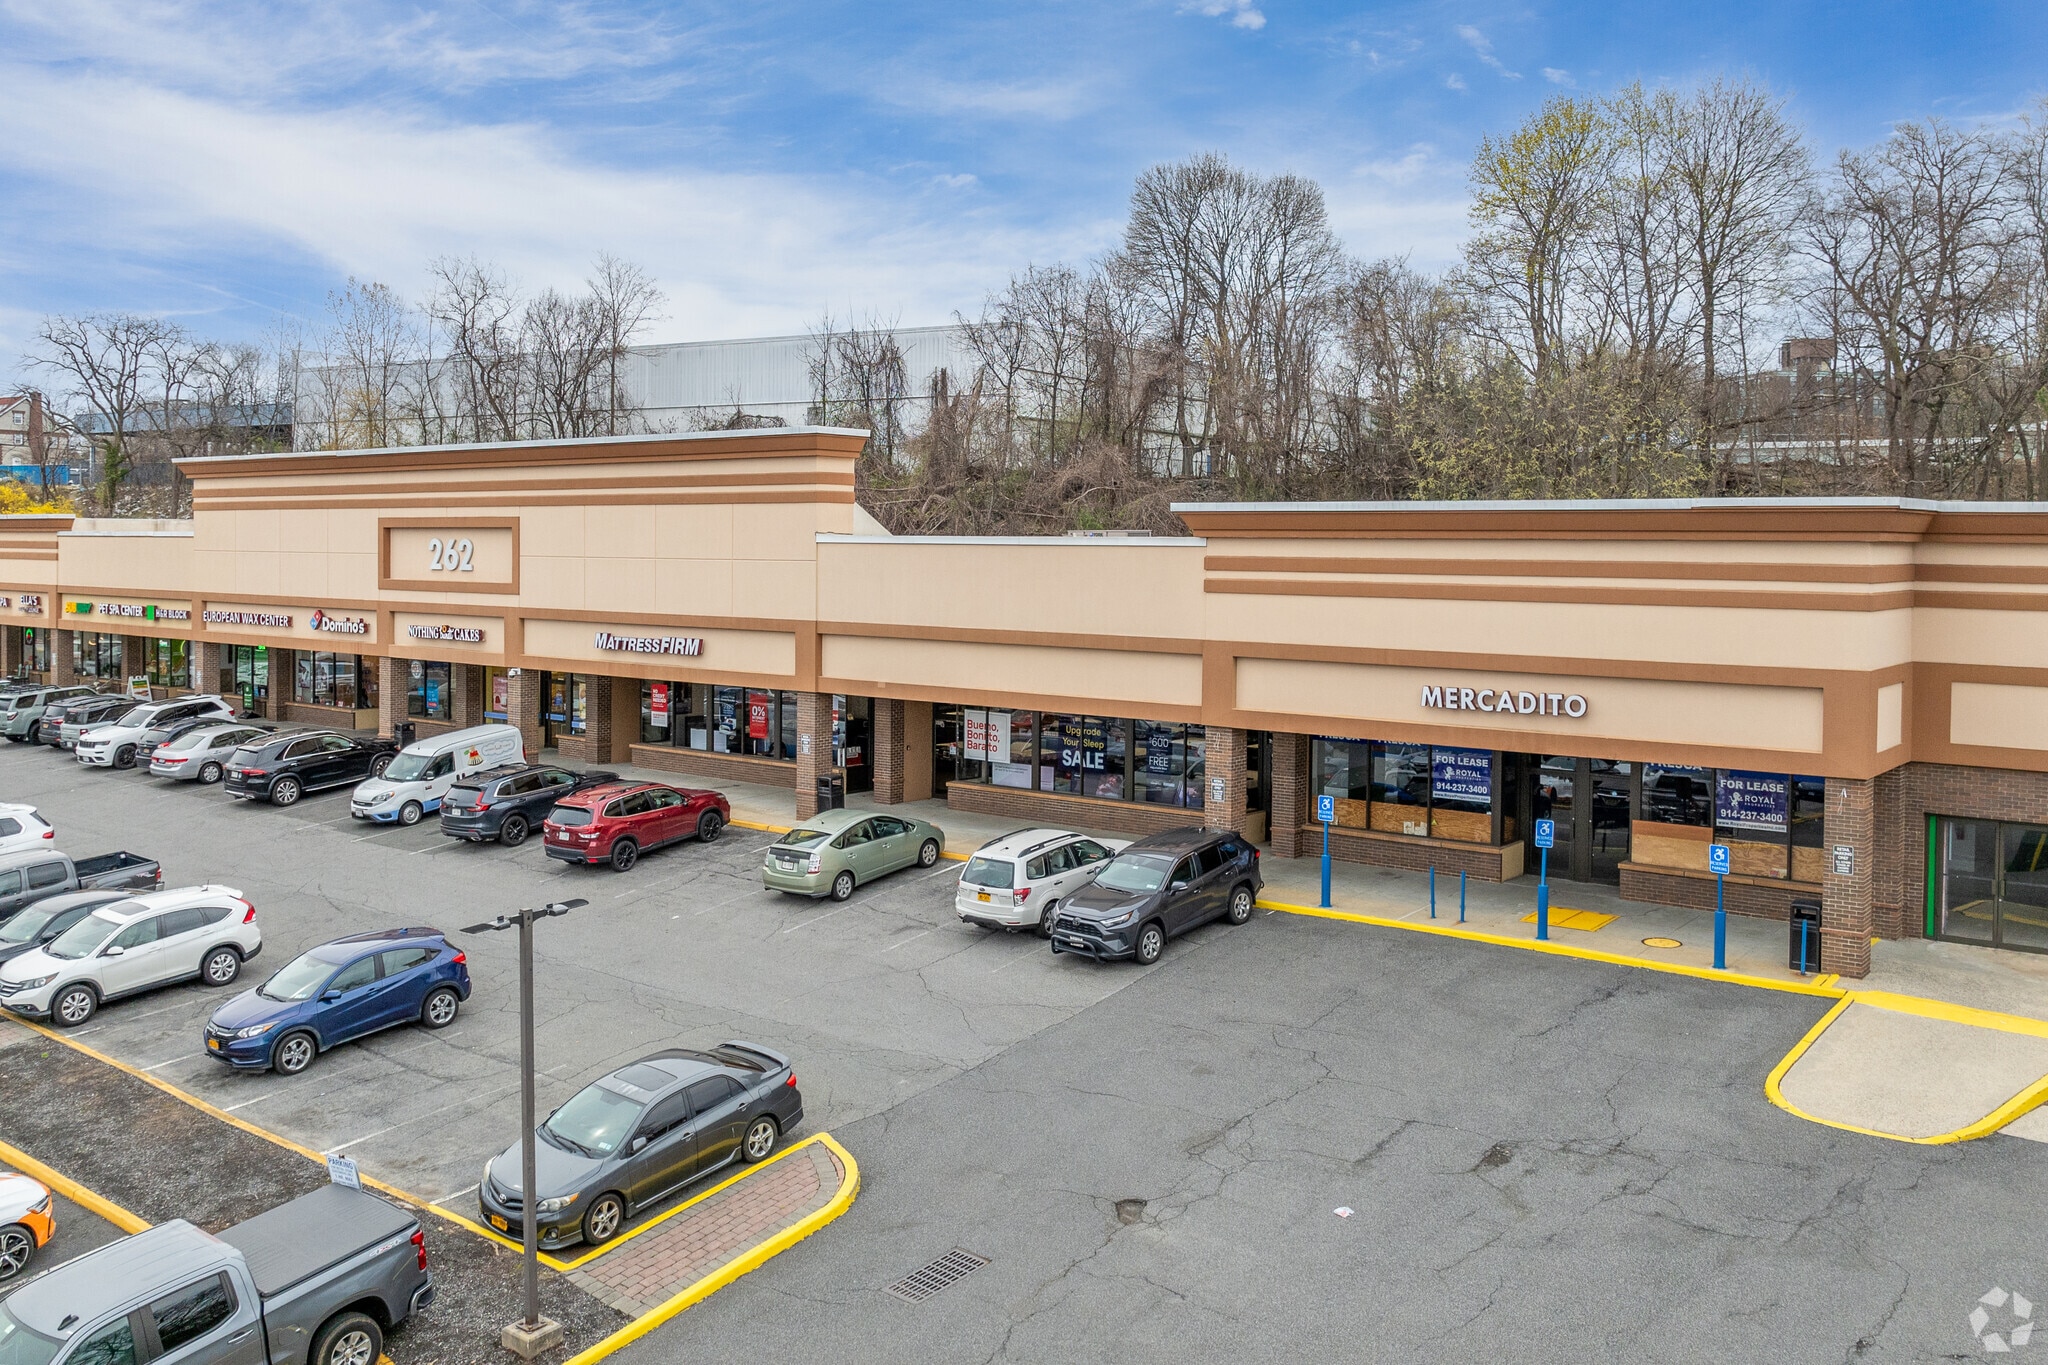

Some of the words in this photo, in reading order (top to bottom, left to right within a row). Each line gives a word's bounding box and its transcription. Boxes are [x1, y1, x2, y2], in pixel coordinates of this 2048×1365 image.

[429, 537, 474, 572] 262
[99, 603, 109, 614] PET
[109, 604, 120, 616] SPA
[121, 604, 143, 617] CENTER
[168, 610, 187, 619] BLOCK
[203, 611, 240, 624] EUROPEAN
[242, 612, 260, 625] WAX
[260, 614, 289, 627] CENTER
[322, 616, 365, 634] Domino's
[408, 625, 439, 639] NOTHING
[454, 628, 481, 642] CAKES
[1420, 685, 1588, 718] MERCADITO
[751, 705, 766, 717] 0%
[1062, 736, 1080, 747] Your
[1082, 738, 1105, 751] Sleep
[1062, 749, 1104, 770] SALE
[1149, 755, 1169, 768] FREE
[1435, 755, 1455, 765] FOR
[1457, 757, 1489, 768] LEASE
[1455, 769, 1482, 778] ROYAL
[1436, 781, 1488, 795] 914-237-3400
[1720, 779, 1743, 790] FOR
[1746, 781, 1785, 793] LEASE
[1744, 794, 1776, 805] ROYAL
[1720, 808, 1783, 823] 914-237-3400
[328, 1157, 354, 1170] PARKING
